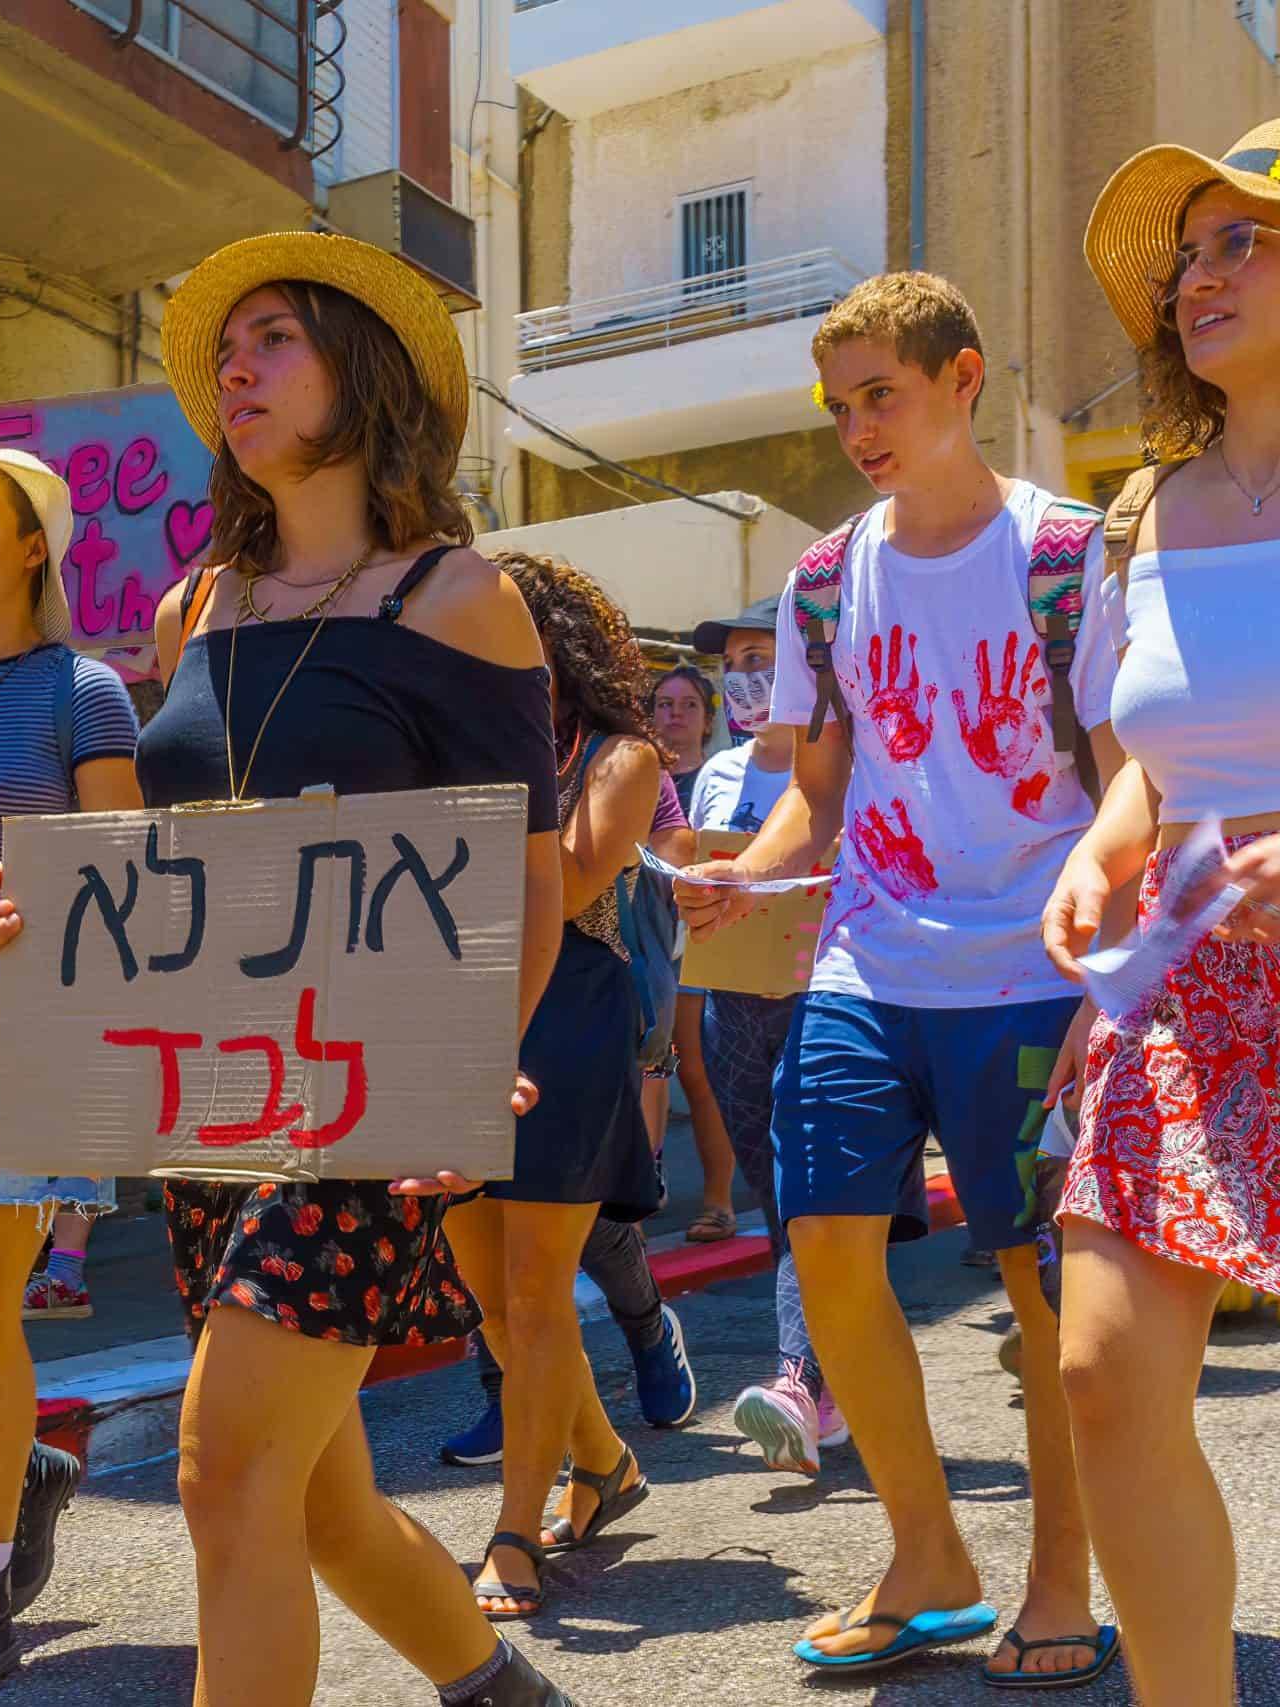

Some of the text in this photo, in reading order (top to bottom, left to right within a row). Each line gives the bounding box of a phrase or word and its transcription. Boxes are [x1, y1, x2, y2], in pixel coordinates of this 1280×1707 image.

[60, 822, 470, 987] את לא
[102, 987, 368, 1149] לבד
